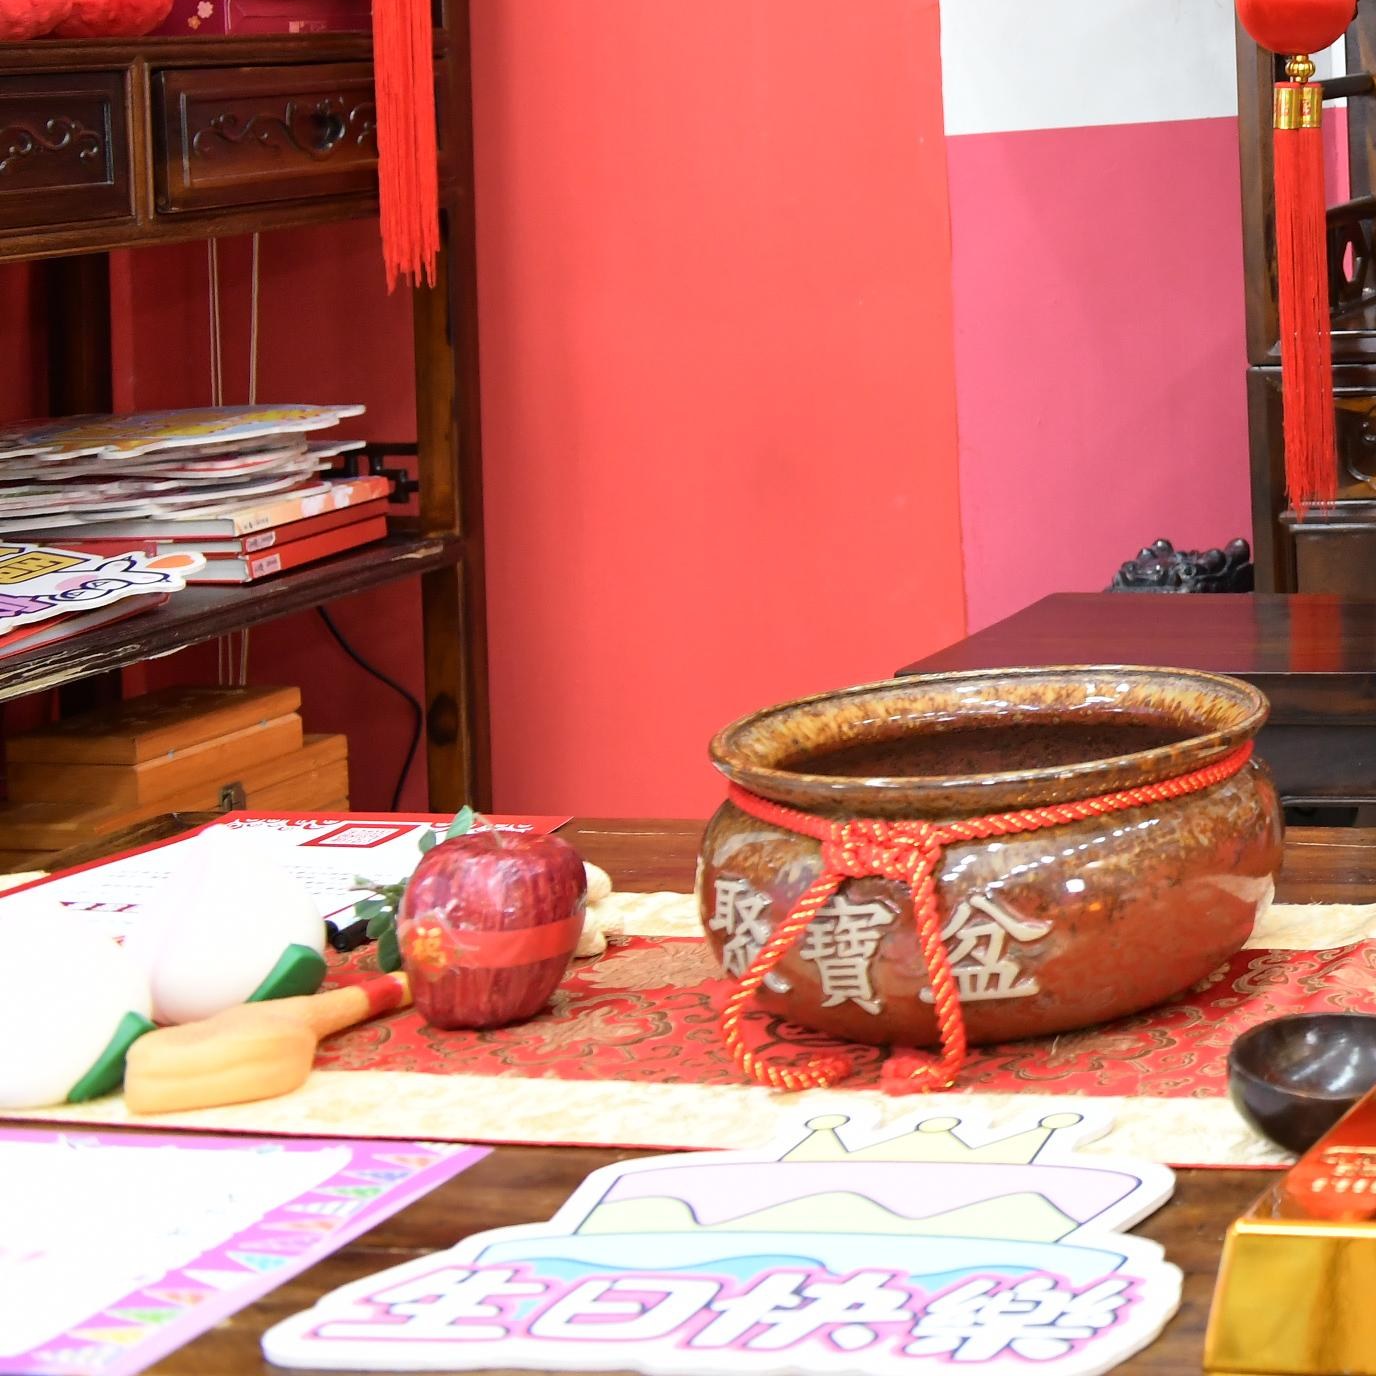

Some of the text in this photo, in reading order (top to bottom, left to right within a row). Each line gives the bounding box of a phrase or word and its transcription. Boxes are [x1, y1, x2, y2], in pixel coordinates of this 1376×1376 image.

[709, 877, 1052, 1016] 聚寶盆
[308, 1266, 1138, 1363] 生日快樂
